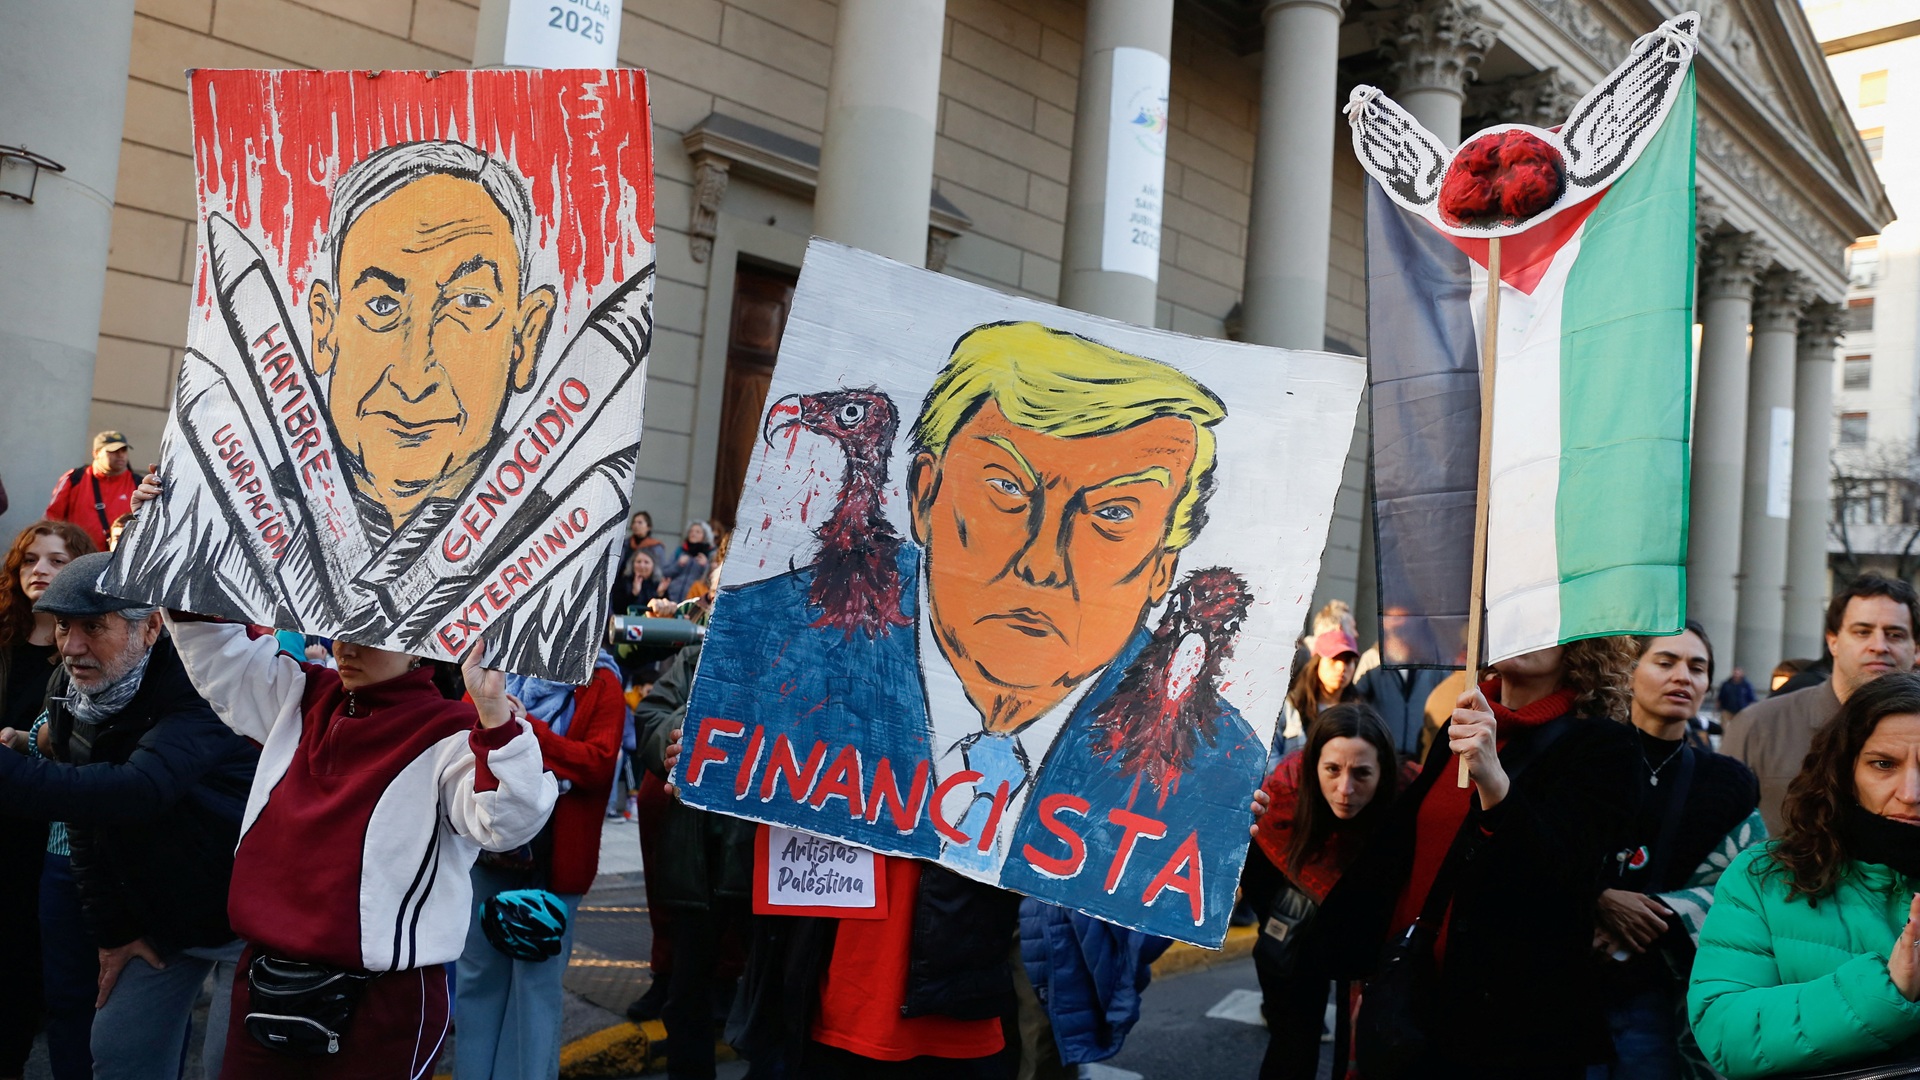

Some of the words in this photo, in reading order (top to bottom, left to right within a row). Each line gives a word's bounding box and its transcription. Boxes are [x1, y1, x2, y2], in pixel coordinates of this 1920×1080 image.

[548, 6, 605, 45] 2025
[568, 0, 610, 20] LAR
[252, 323, 332, 491] HAMBRE
[442, 377, 591, 563] GENOCIDIO
[437, 507, 590, 656] EXTERMINIO
[685, 717, 1205, 927] FINANCISTA
[781, 836, 858, 864] Artistas
[777, 866, 864, 895] Palestina
